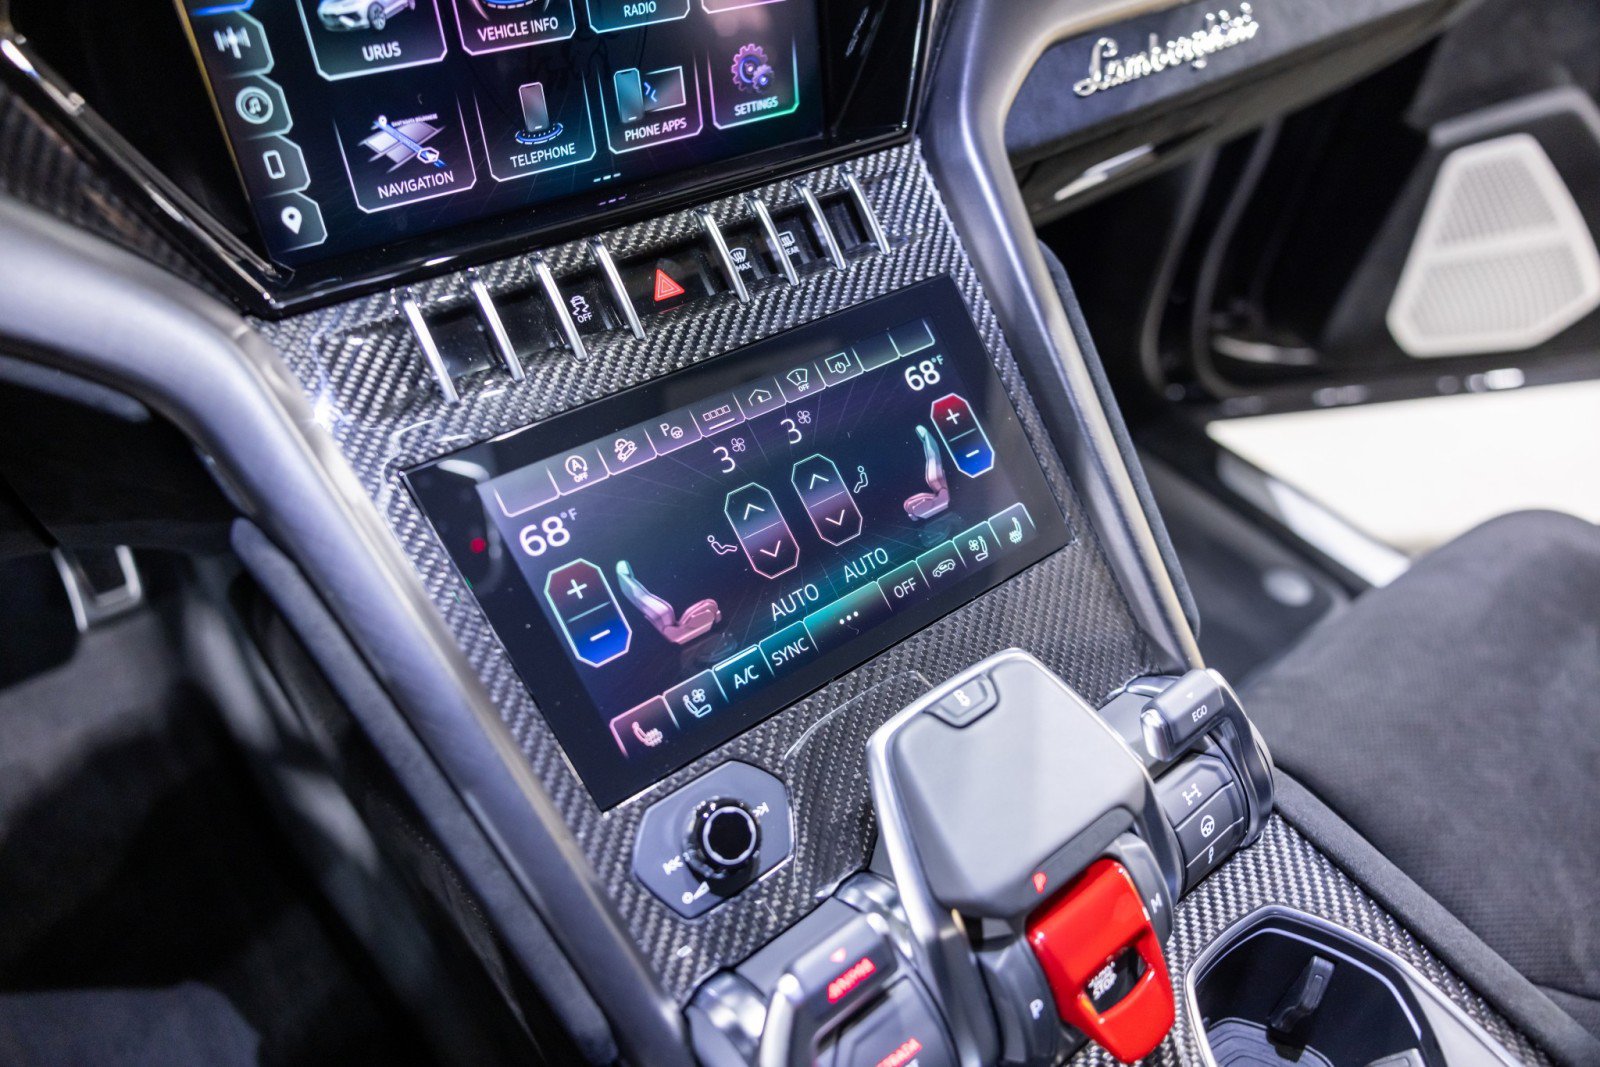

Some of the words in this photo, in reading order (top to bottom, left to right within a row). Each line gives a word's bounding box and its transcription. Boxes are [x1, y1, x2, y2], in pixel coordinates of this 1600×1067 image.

[624, 2, 657, 18] RADIO
[477, 22, 529, 42] VEHICLE
[530, 16, 559, 33] INFO
[362, 41, 402, 62] URUS
[1073, 2, 1259, 97] Lamborghini
[734, 96, 779, 117] SETTINGS
[624, 122, 661, 142] PHONE
[661, 117, 687, 133] APPS
[510, 142, 576, 168] TELEPHONE
[377, 171, 454, 199] NAVIGATION
[735, 261, 752, 274] MAX
[577, 313, 592, 323] OFF
[798, 383, 810, 393] OFF
[780, 418, 802, 444] 3
[713, 446, 736, 473] 3
[573, 471, 588, 483] OFF
[843, 547, 889, 583] AUTO
[893, 577, 917, 599] OFF
[770, 583, 819, 622] AUTO
[771, 637, 809, 667] SYNC
[733, 664, 759, 689] A/C
[1150, 892, 1163, 914] M
[1093, 972, 1118, 1001] STOP
[1030, 998, 1044, 1020] P
